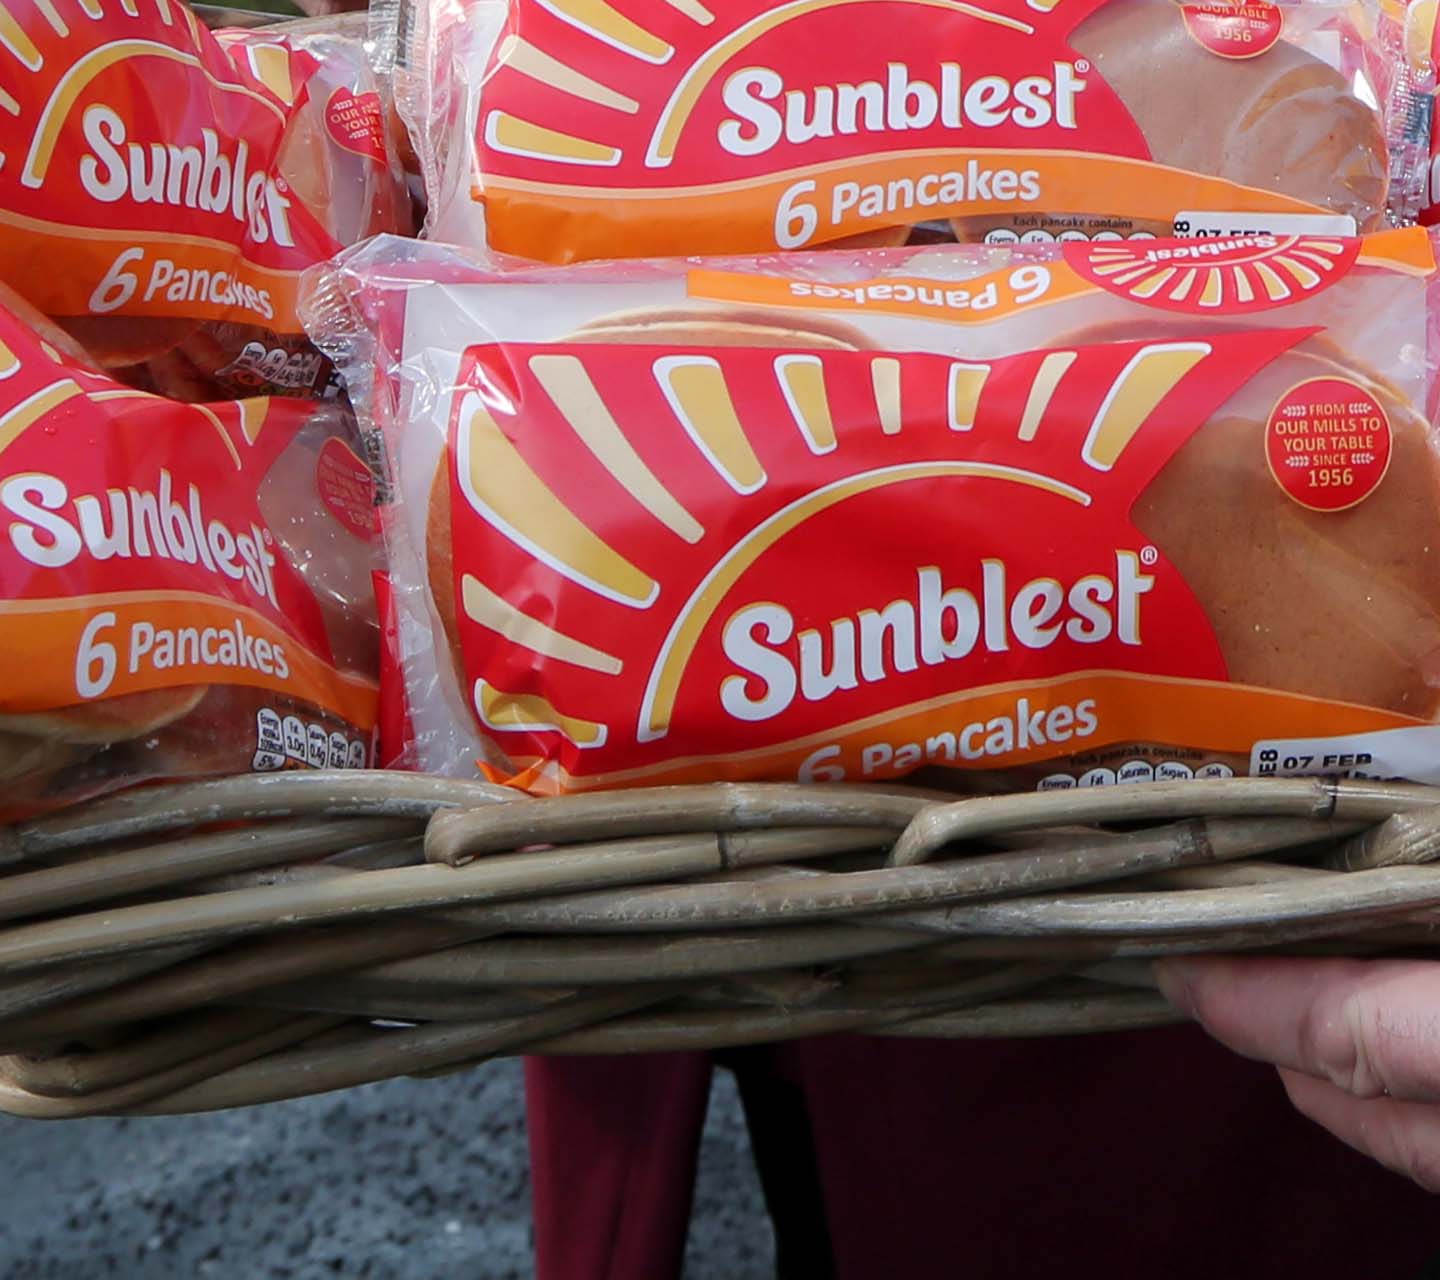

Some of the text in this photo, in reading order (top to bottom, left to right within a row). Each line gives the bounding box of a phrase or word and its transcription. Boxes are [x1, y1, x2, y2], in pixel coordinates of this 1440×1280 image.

[330, 108, 360, 123] OUR
[717, 60, 1087, 157] Sunblest
[773, 159, 1041, 250] 6 Pancakes
[88, 247, 145, 312] 6
[789, 265, 1052, 311] 6 Pancakes
[1309, 404, 1345, 415] FROM
[1275, 417, 1381, 435] OUR MILLS TO
[1283, 435, 1374, 452] YOUR TABLE
[1312, 454, 1347, 466] SINCE
[1308, 468, 1354, 488] 1956
[719, 549, 1155, 722] Sunblest
[75, 612, 289, 699] 6 Pancakes
[862, 698, 1098, 775] Pancakes
[1206, 767, 1222, 778] Salt
[1283, 756, 1314, 770] 07
